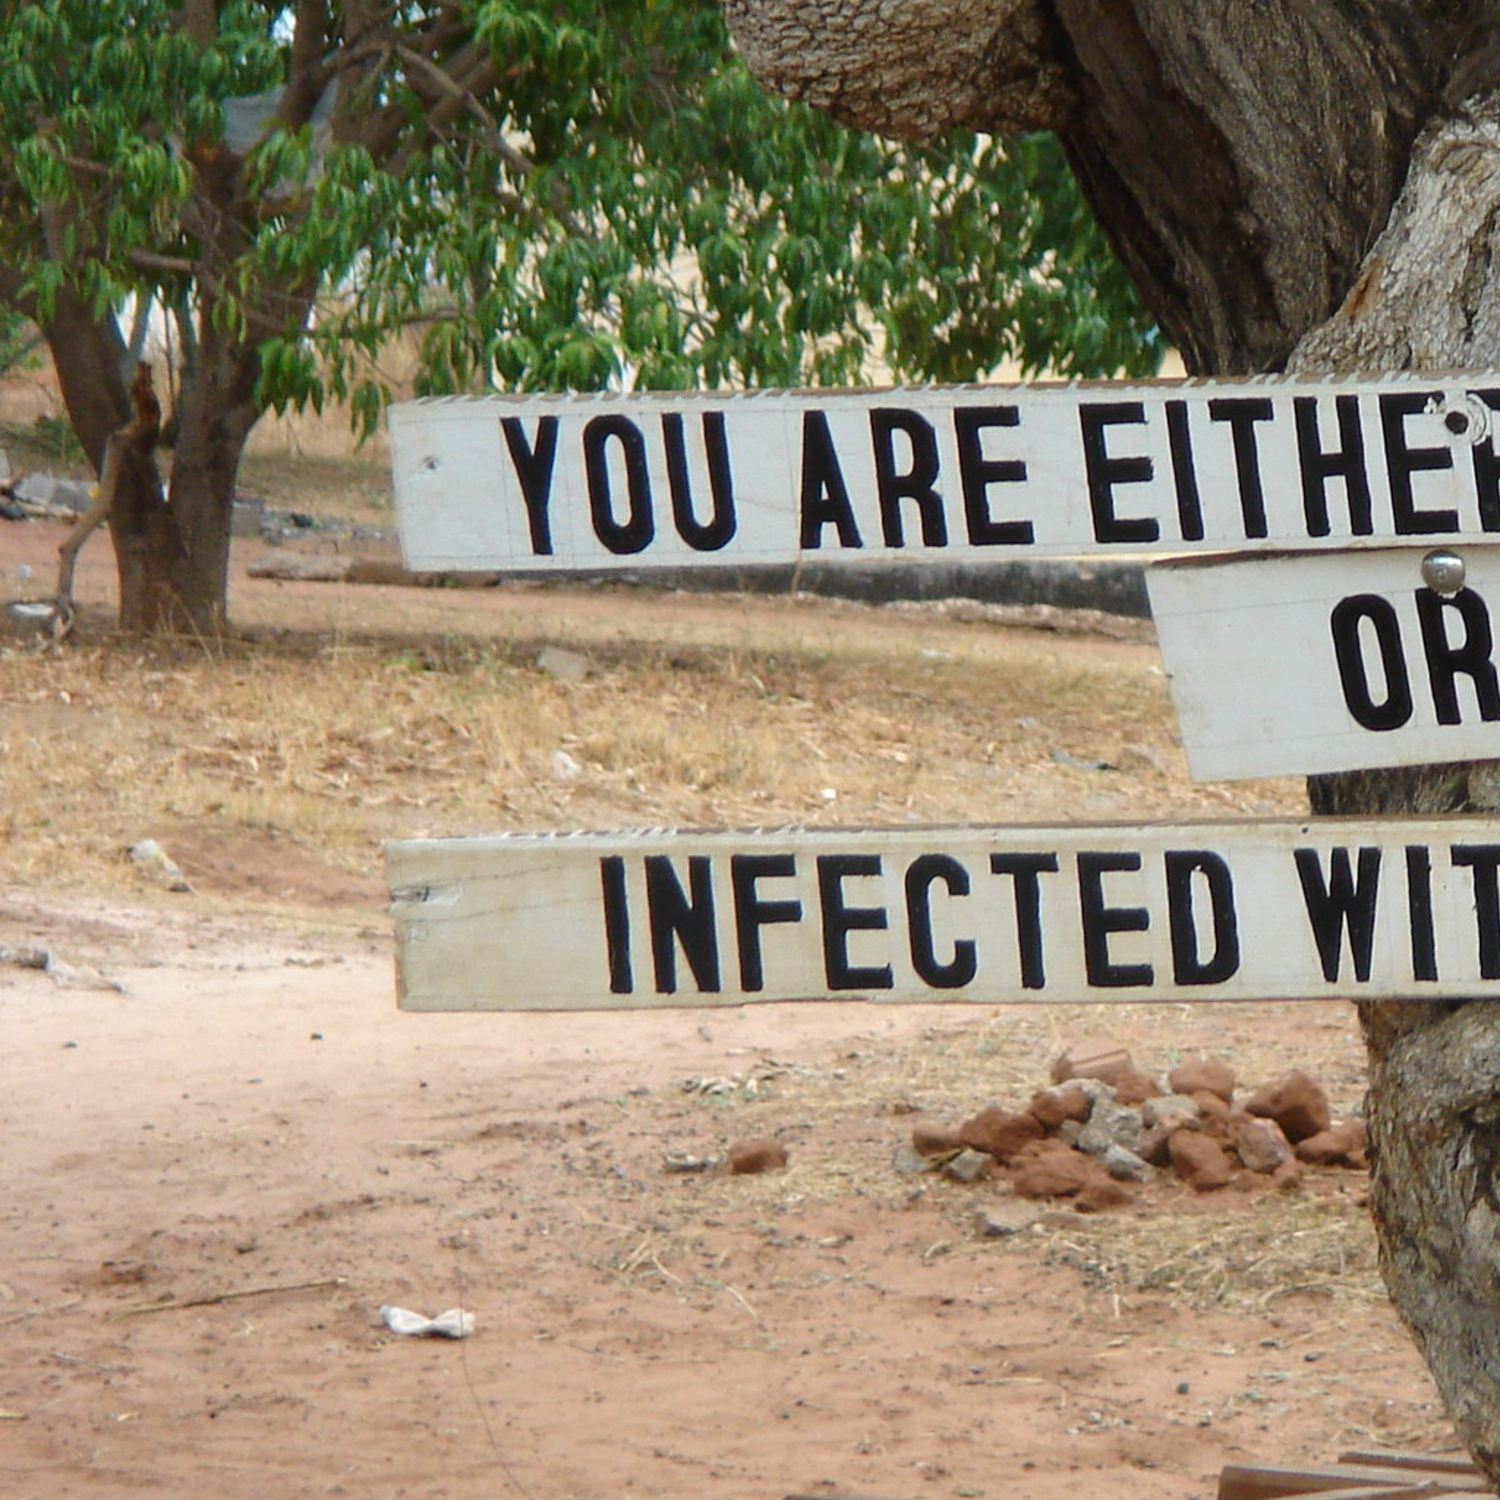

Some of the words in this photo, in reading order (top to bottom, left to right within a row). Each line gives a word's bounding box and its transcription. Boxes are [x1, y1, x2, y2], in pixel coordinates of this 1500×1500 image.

[500, 411, 737, 556] YOU
[799, 405, 1035, 550] ARE
[600, 851, 1240, 995] INFECTED
